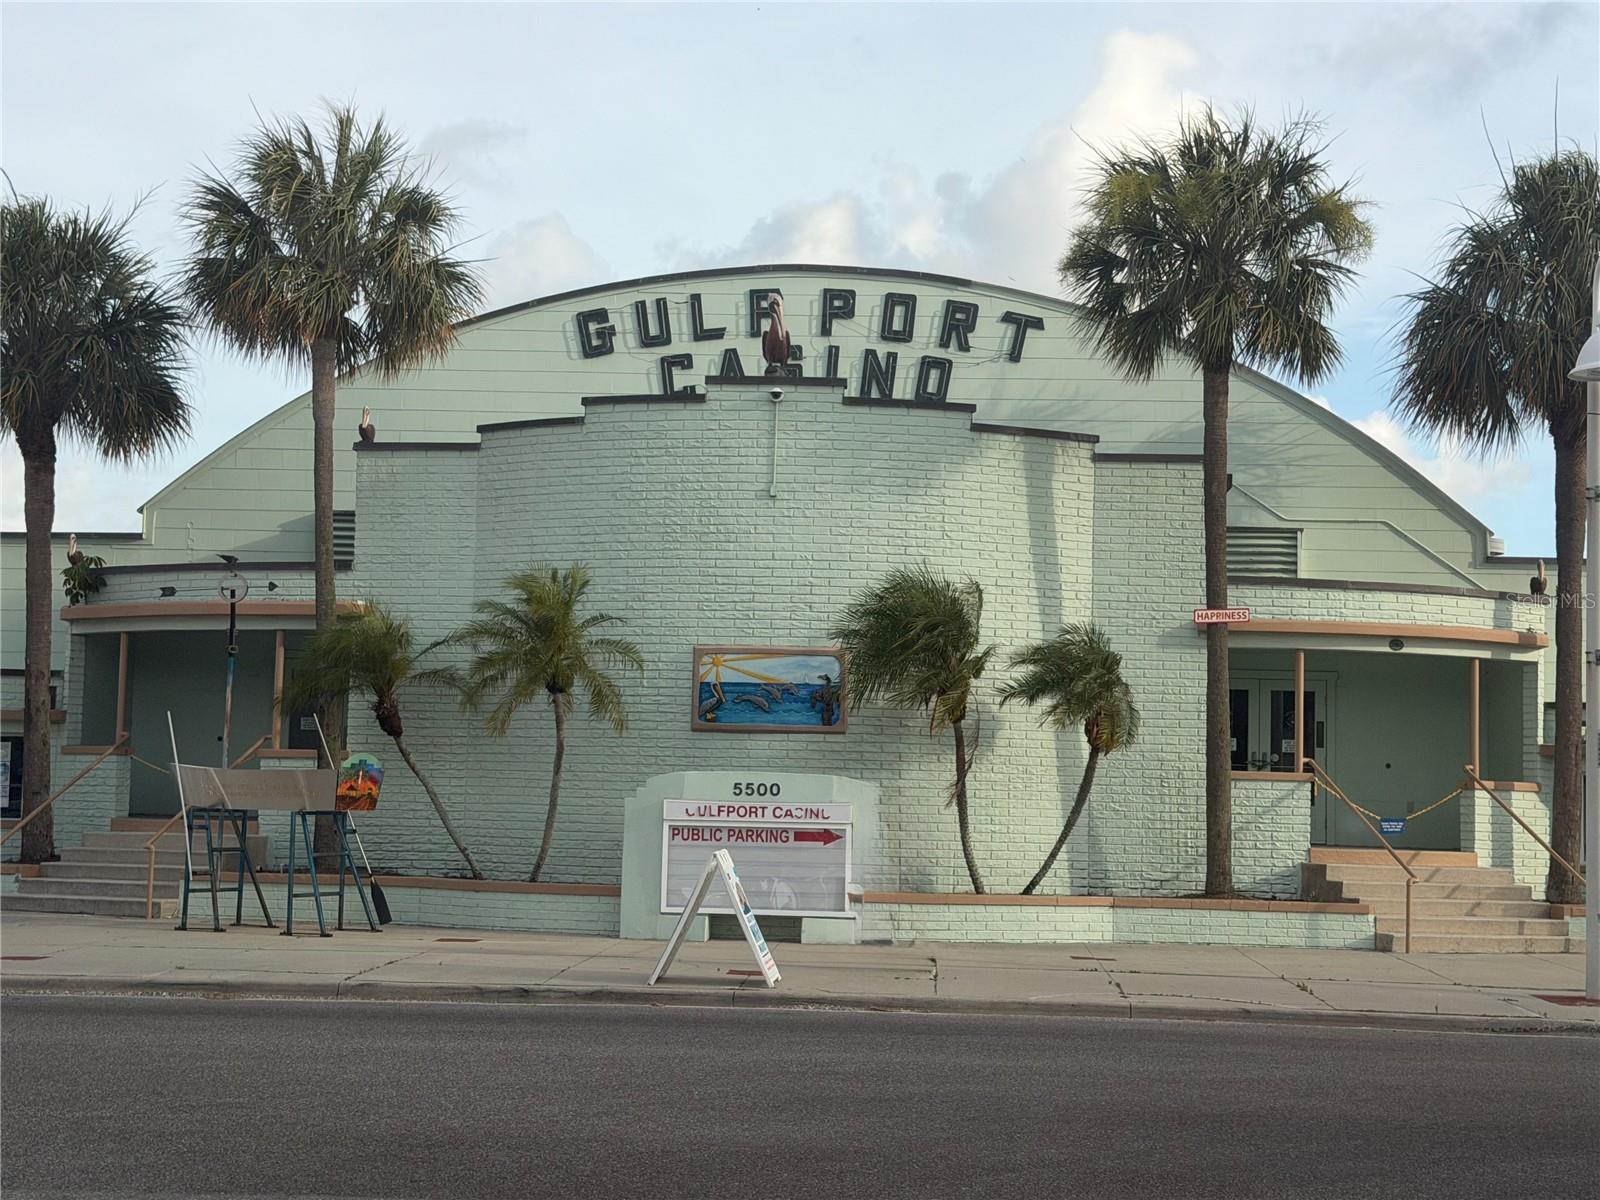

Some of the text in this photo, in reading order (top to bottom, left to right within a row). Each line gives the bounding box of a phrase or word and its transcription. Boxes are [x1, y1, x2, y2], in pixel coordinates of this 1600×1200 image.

[1196, 611, 1248, 621] HAPPINESS
[732, 782, 781, 797] 5500
[671, 827, 790, 843] PUBLIC PARKING
